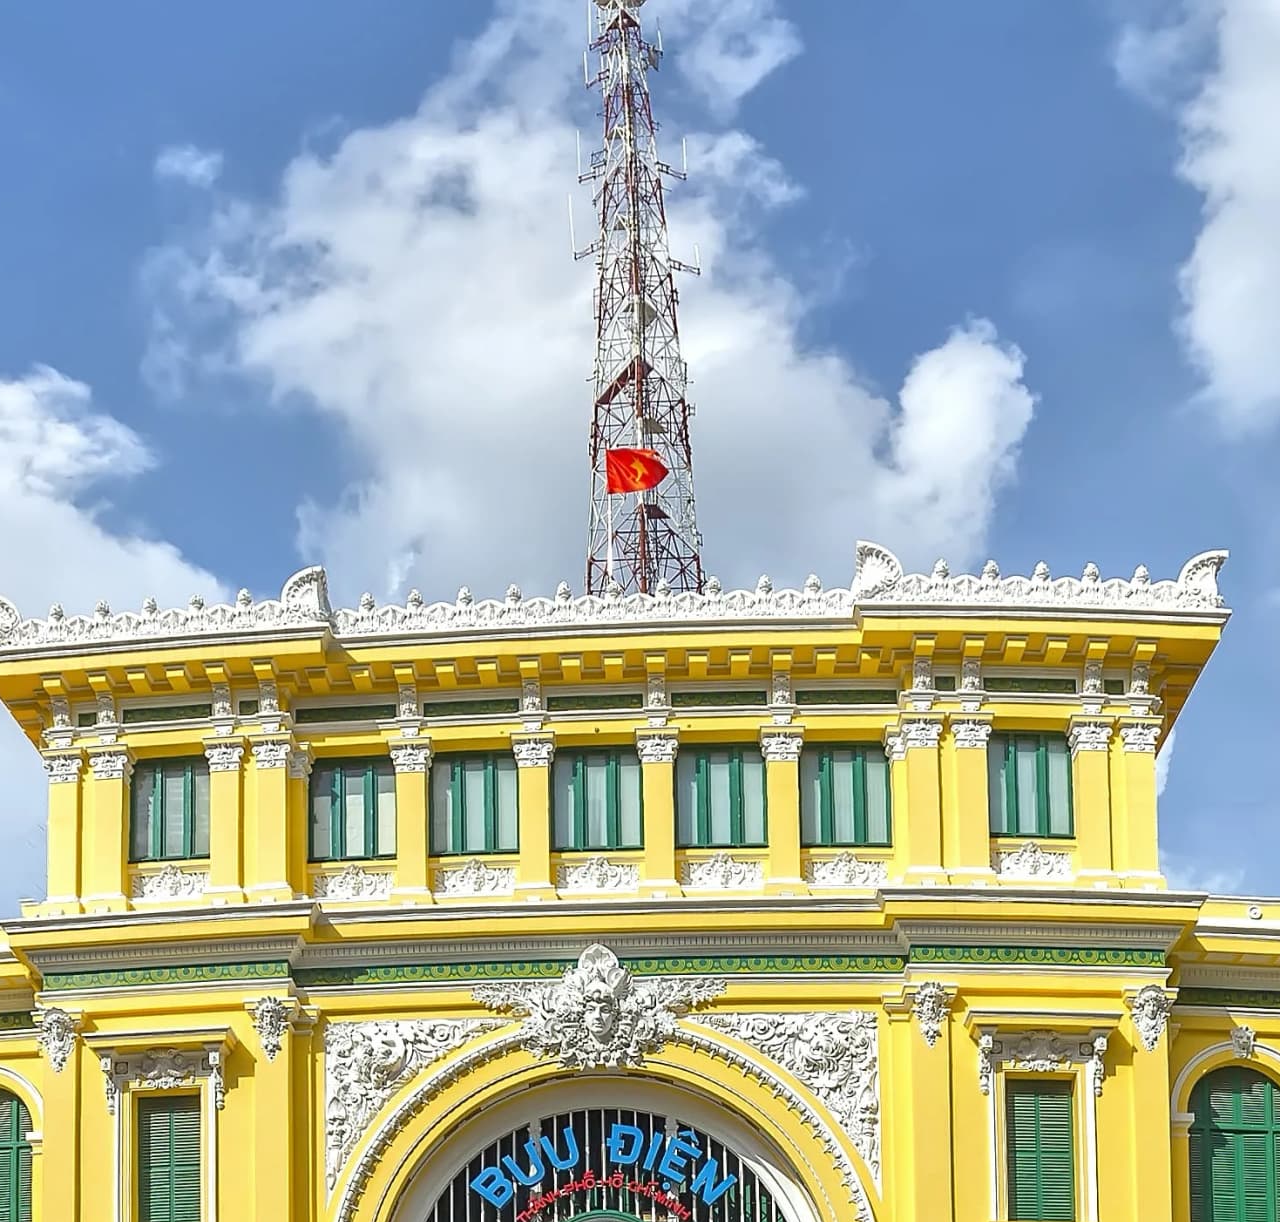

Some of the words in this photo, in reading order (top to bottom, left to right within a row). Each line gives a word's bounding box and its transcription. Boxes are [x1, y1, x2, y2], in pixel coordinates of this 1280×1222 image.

[563, 1169, 596, 1193] PHỐ
[600, 1169, 624, 1187] HỒ
[607, 1123, 738, 1206] ĐIỆN
